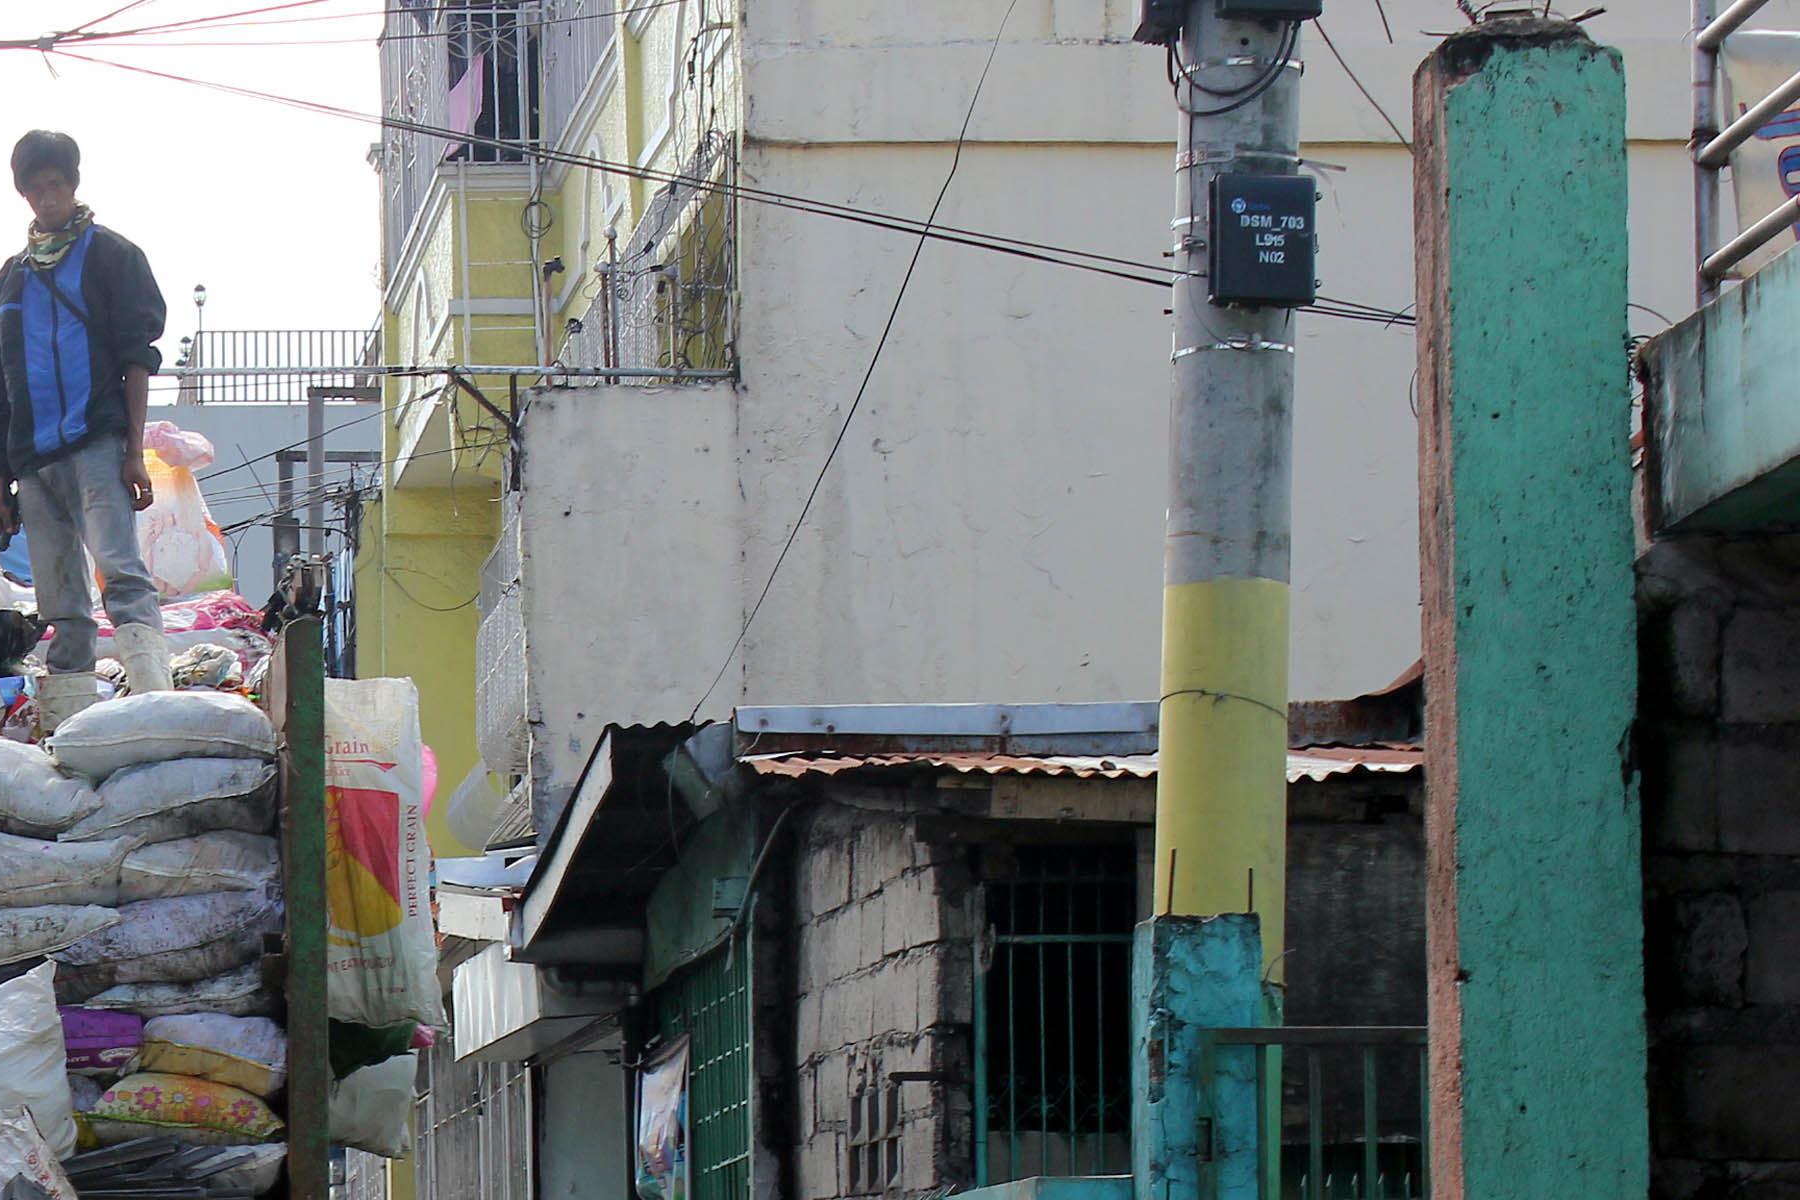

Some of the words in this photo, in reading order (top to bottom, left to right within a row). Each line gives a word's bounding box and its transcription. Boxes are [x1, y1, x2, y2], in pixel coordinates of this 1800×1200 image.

[1240, 214, 1305, 231] DSM_703
[407, 804, 418, 853] GRAIN
[407, 856, 418, 918] PERFECT
